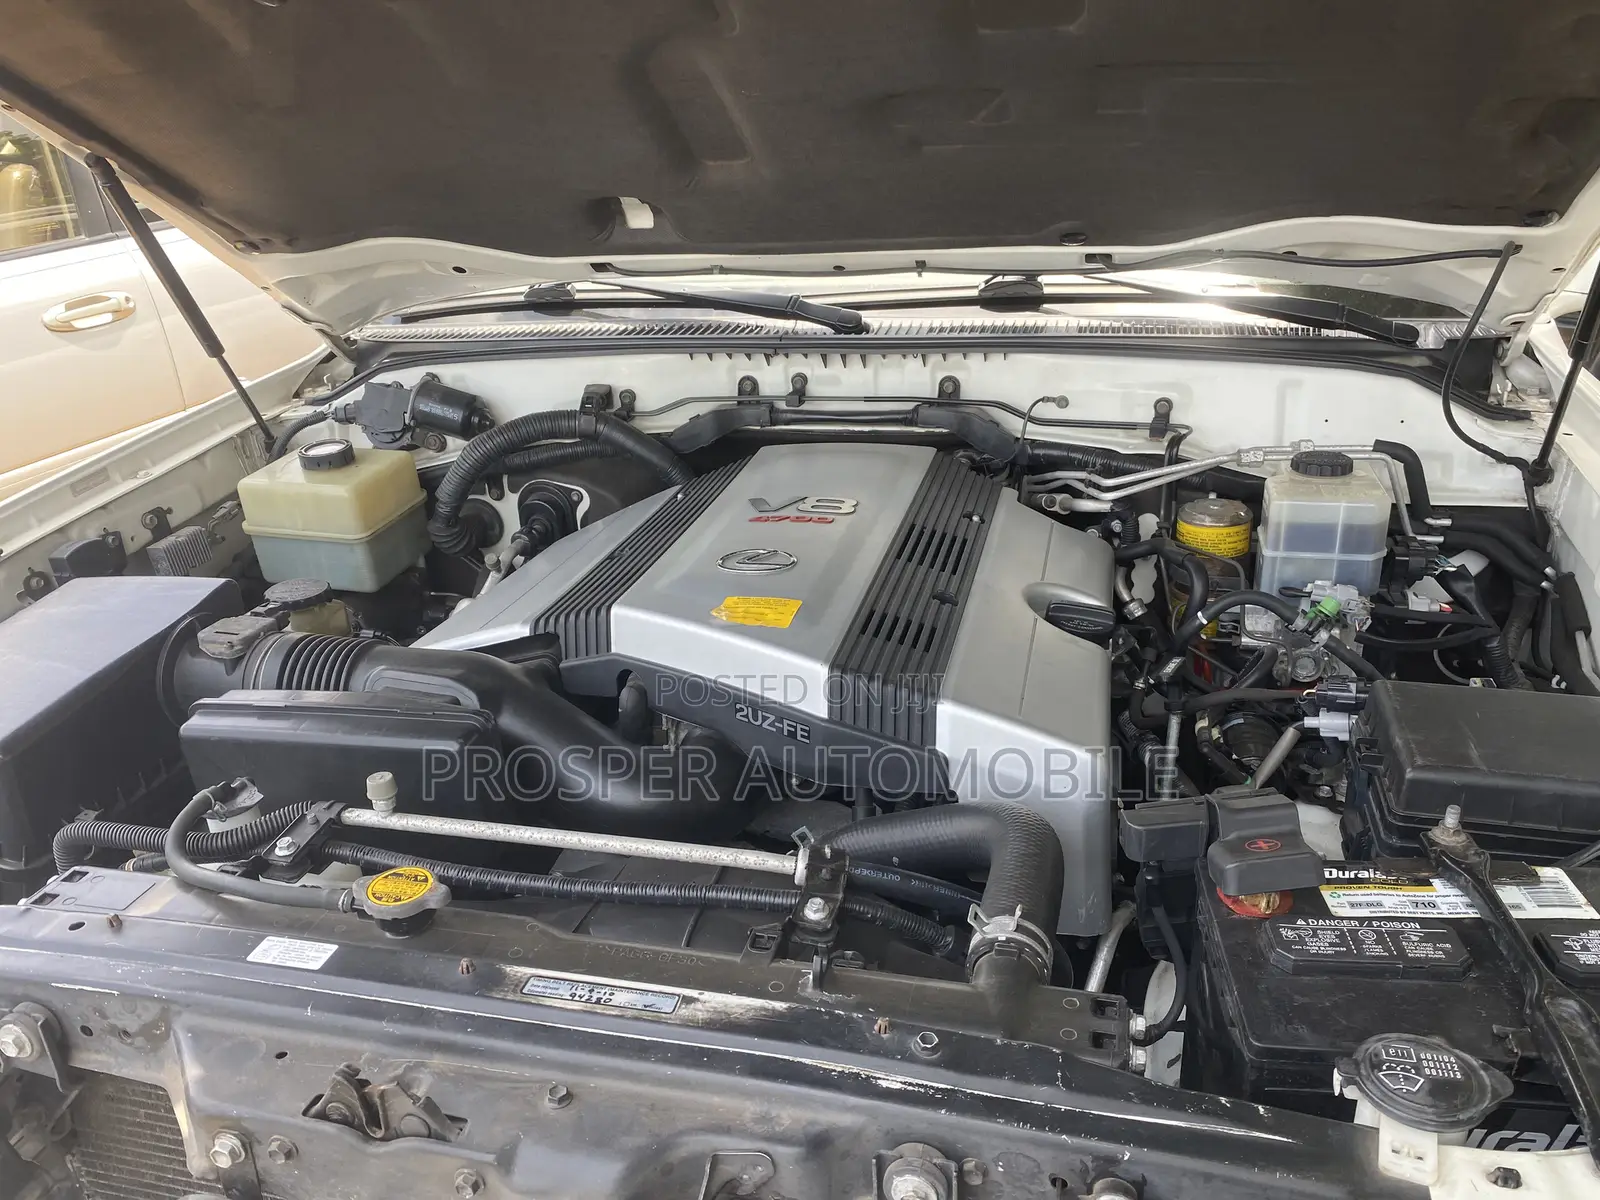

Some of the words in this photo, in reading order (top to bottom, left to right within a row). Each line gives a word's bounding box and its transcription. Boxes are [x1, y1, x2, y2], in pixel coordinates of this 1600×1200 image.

[748, 497, 859, 515] V8
[735, 703, 811, 744] 2UZ-FE
[1411, 901, 1437, 909] 710
[1308, 918, 1360, 927] DANGER
[1372, 920, 1420, 929] POISON
[1422, 1060, 1459, 1071] 001112
[1425, 1068, 1462, 1079] 001113
